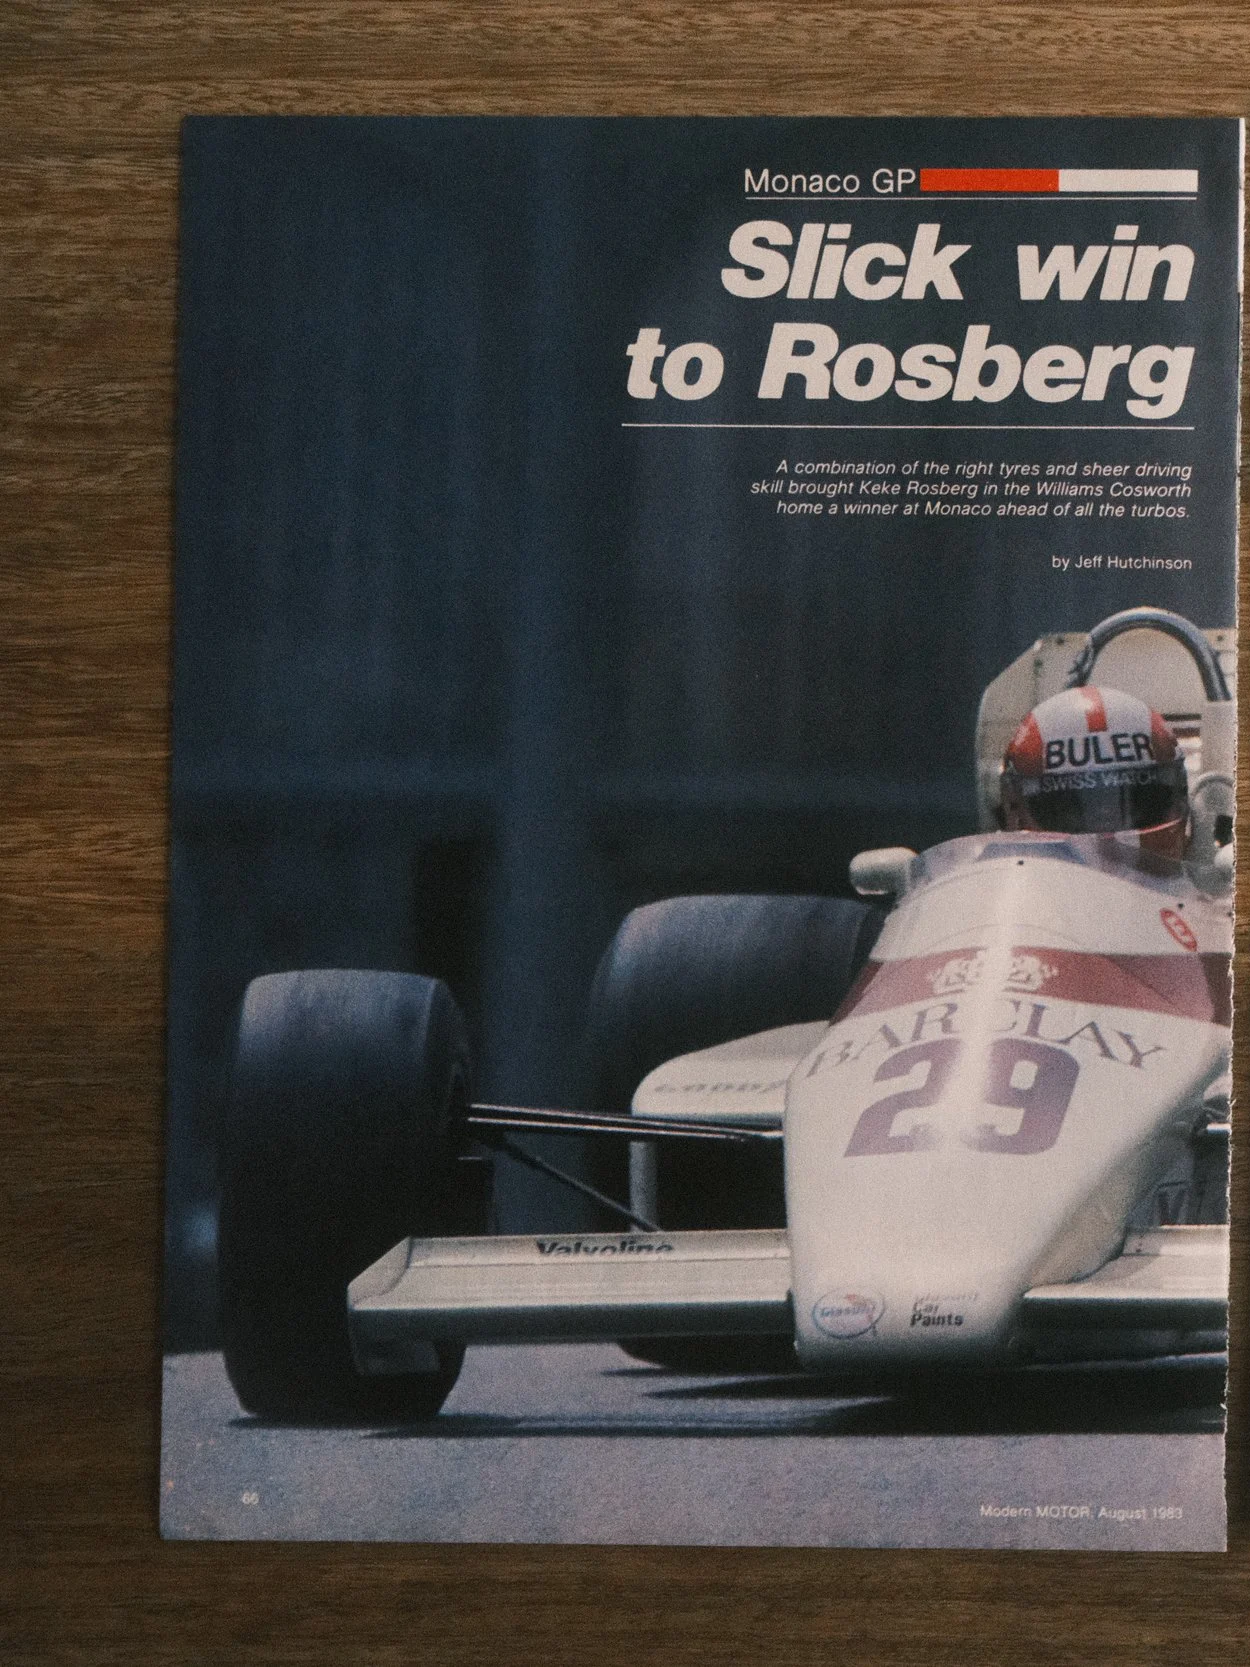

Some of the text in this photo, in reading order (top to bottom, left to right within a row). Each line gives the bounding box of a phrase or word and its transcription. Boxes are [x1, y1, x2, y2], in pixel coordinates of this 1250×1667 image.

[744, 167, 917, 194] Monaco GP
[720, 219, 1196, 302] Slick win
[625, 321, 1196, 420] to Rosberg
[775, 458, 1194, 482] A combination of the right tyres and sheer driving
[750, 478, 1193, 500] skill brought Keke Rosberg in the Williams Cosworth
[776, 499, 1191, 519] home a winner at Monaco ahead of all the turbos.
[1051, 553, 1193, 574] by Jeff Hutchinson
[1045, 733, 1154, 770] BULER
[844, 1036, 1081, 1158] 29
[909, 1311, 965, 1328] Paints
[979, 1505, 1032, 1519] Modern
[1098, 1505, 1147, 1522] August
[1152, 1505, 1183, 1519] 1983
